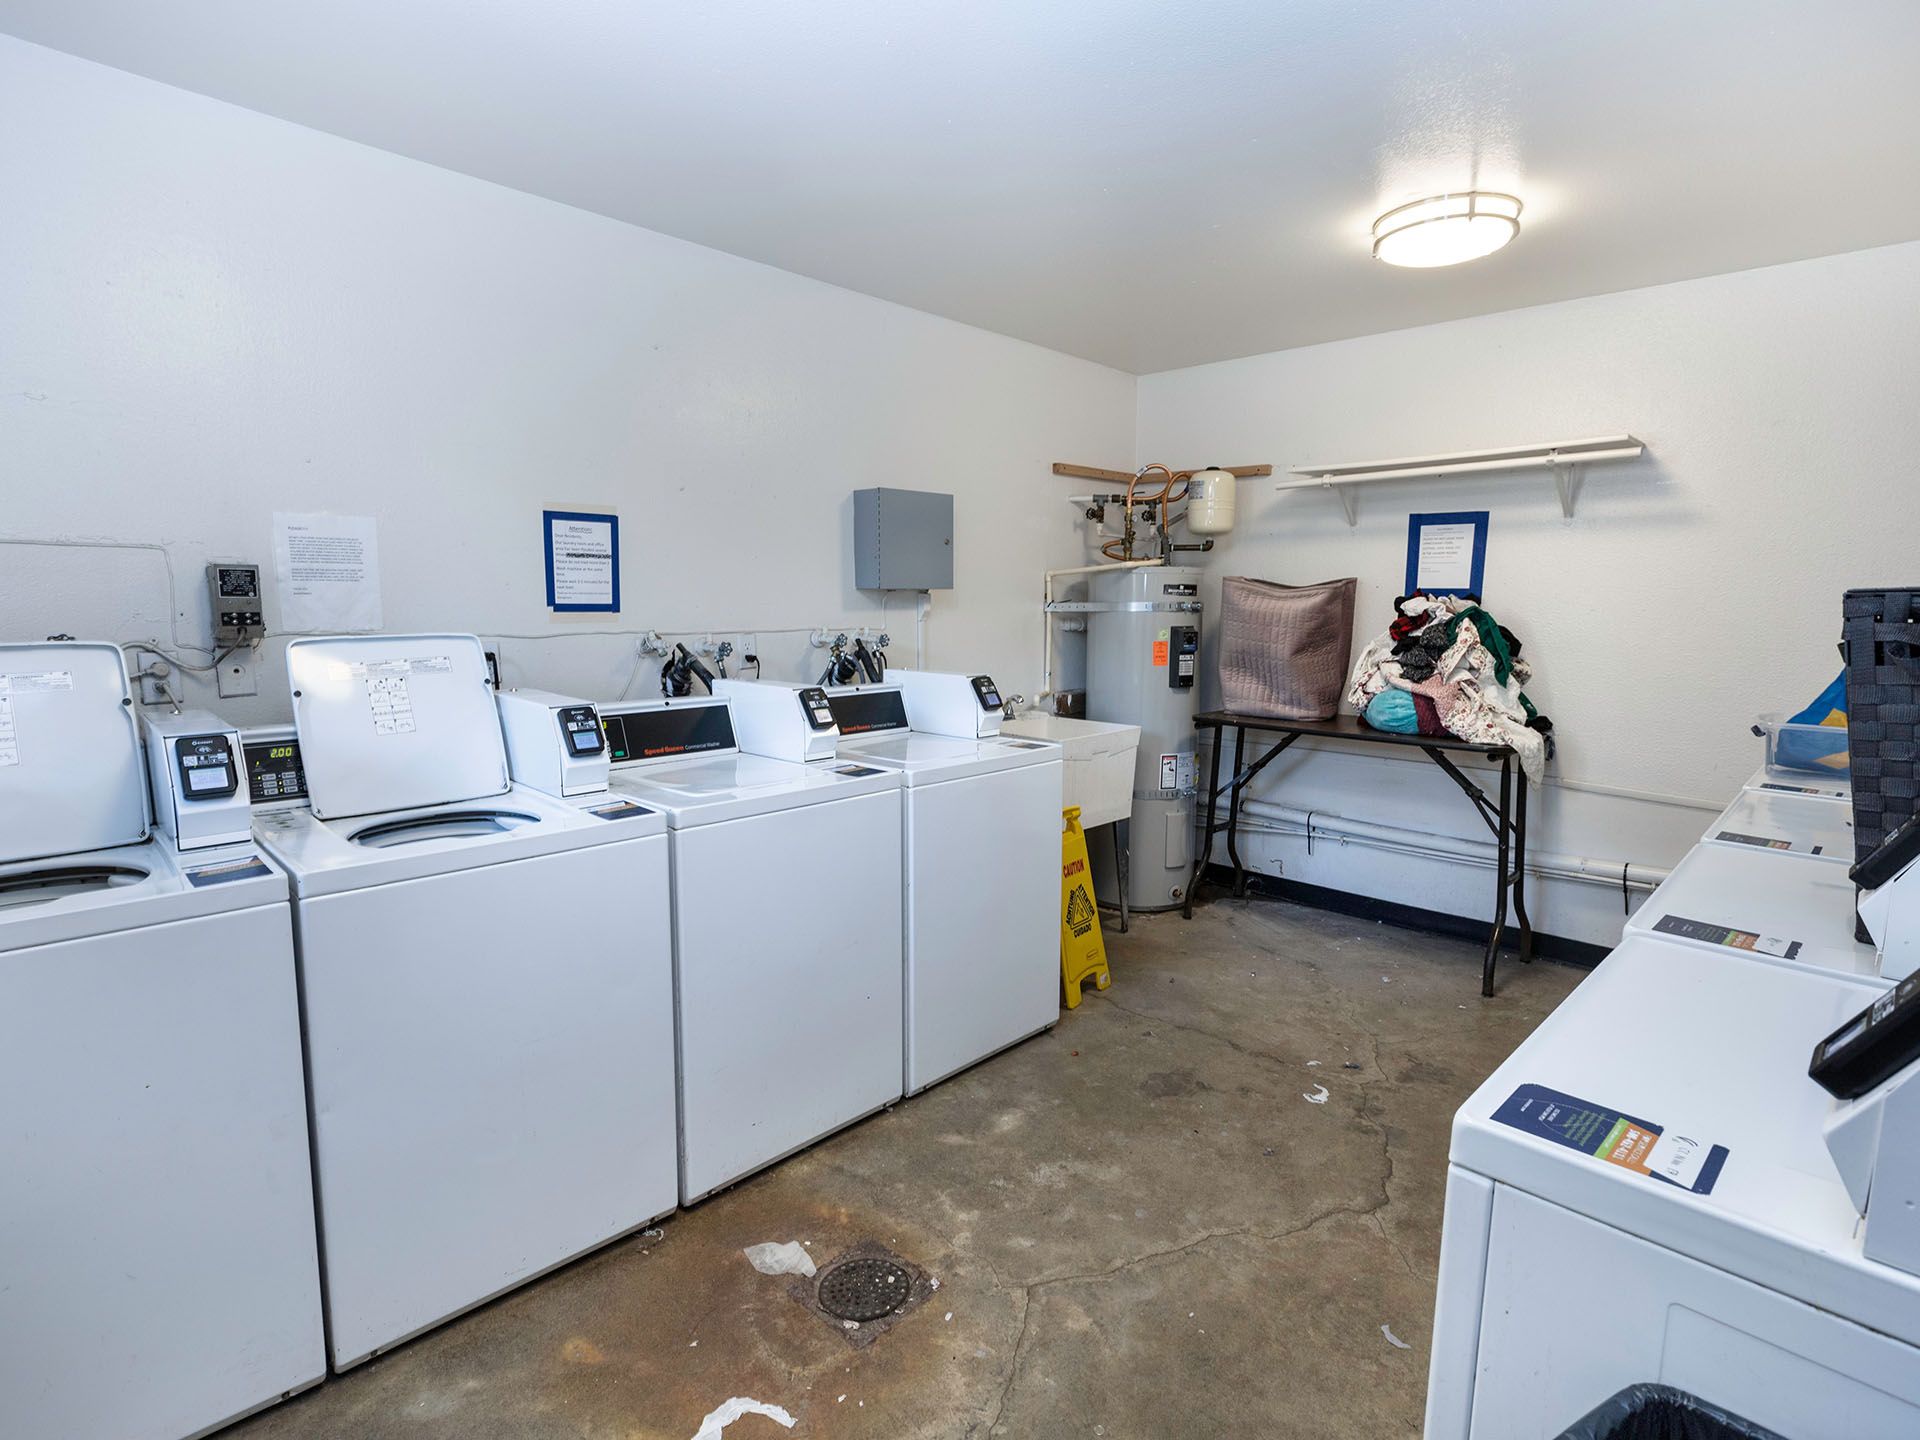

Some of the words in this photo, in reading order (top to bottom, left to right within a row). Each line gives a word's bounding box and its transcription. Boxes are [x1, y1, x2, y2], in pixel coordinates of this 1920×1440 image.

[270, 747, 292, 758] 2.00
[644, 746, 664, 756] Speed
[664, 745, 684, 753] Queen
[1063, 858, 1084, 878] CAUTION
[1066, 889, 1075, 927] ACHTUNG
[1076, 883, 1096, 917] ATTENTION
[1074, 923, 1092, 938] CUIDADO
